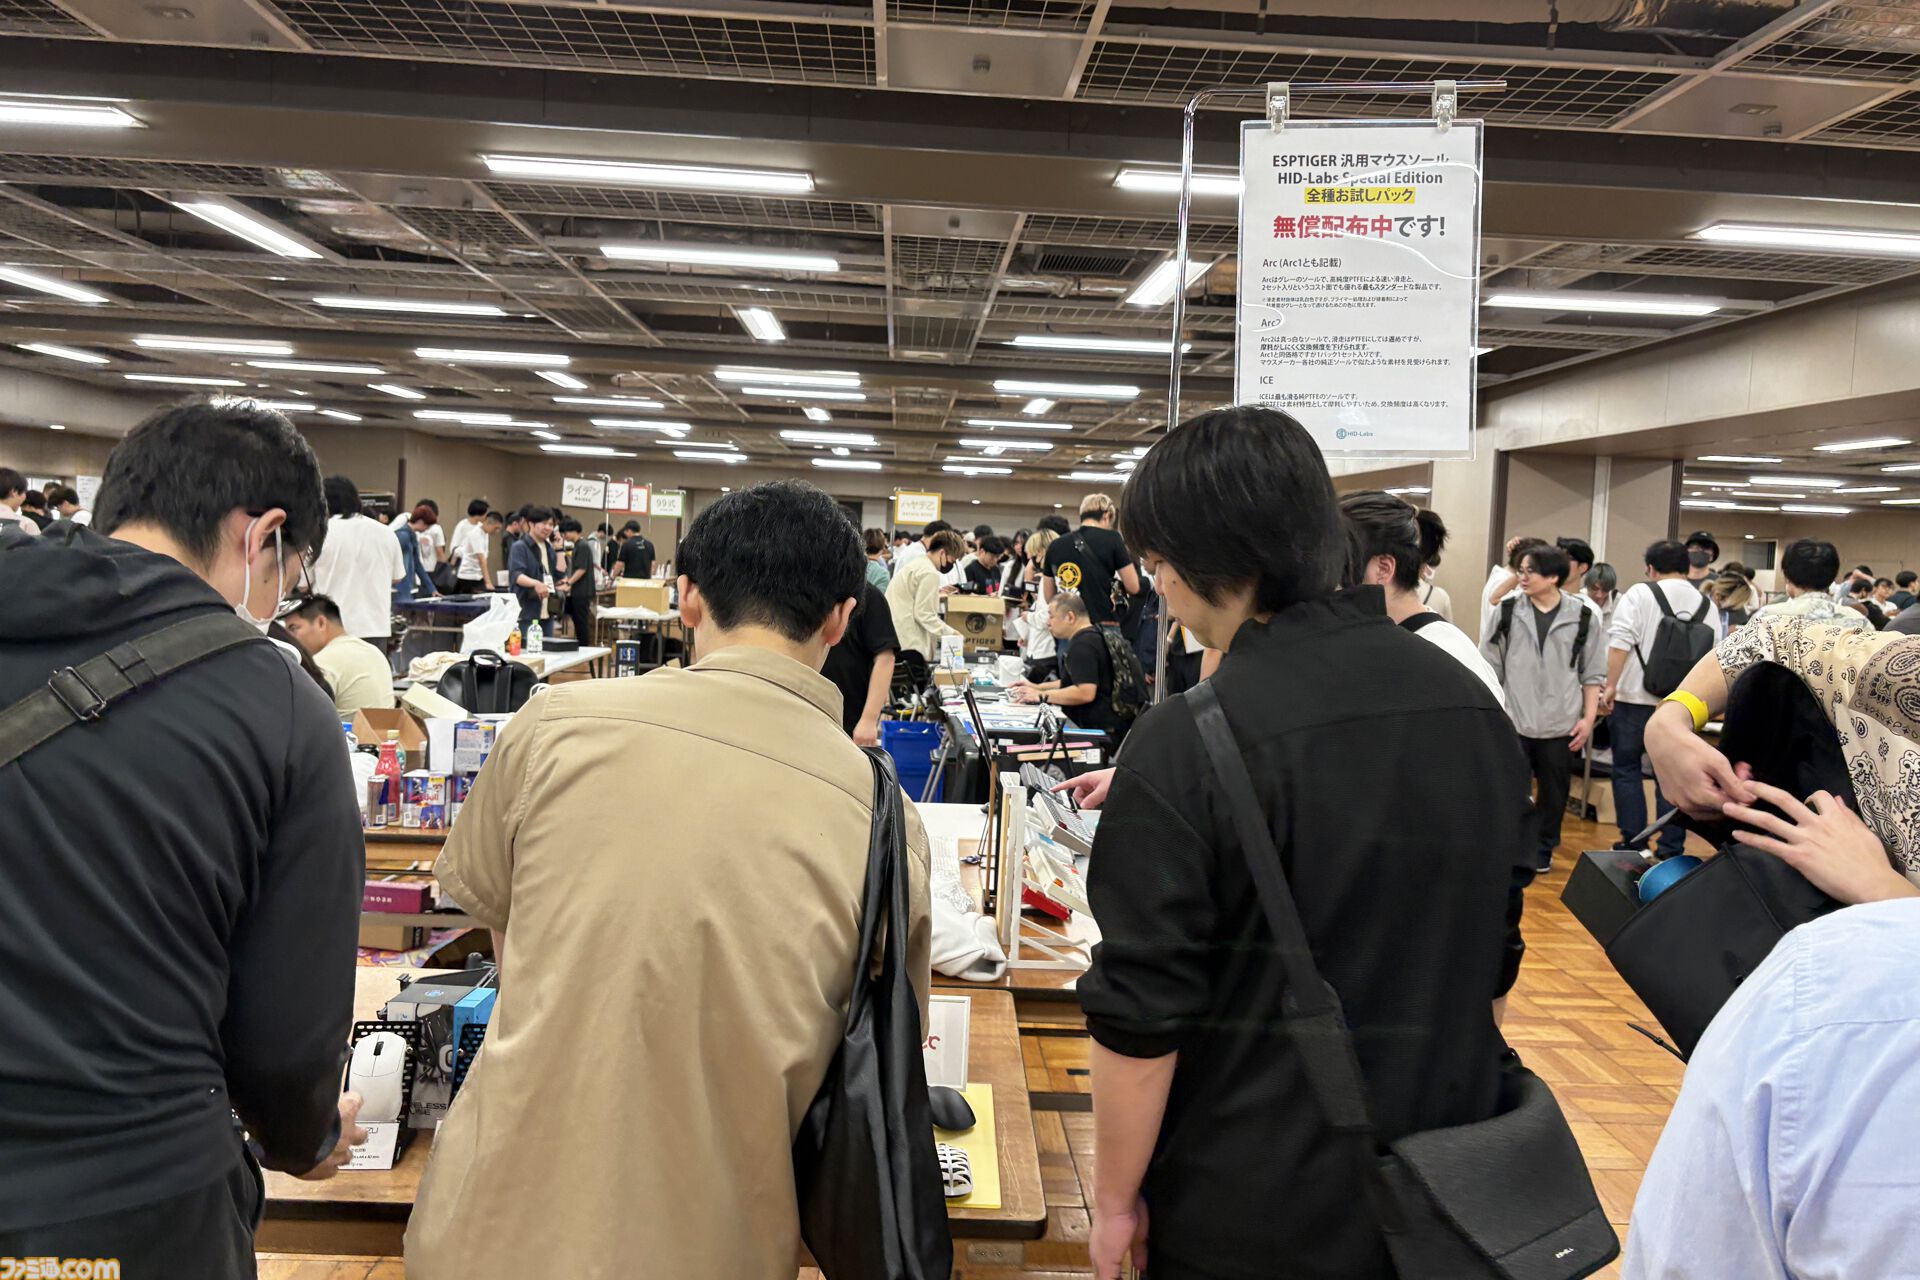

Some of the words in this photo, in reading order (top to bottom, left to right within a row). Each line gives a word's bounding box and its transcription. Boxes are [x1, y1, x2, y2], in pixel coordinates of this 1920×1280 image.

[1272, 155, 1337, 167] ESPTIGER
[1341, 154, 1450, 168] 汎用マウスソール
[1278, 172, 1340, 184] HID-Labs
[1342, 172, 1391, 186] Special
[1394, 172, 1443, 184] Edition
[1306, 188, 1414, 203] 全種お試しパック
[1273, 214, 1446, 239] 無償配布中です!
[1262, 258, 1278, 267] Arc
[1279, 257, 1342, 268] (Arc1とも記載)
[1259, 376, 1274, 385] ICE
